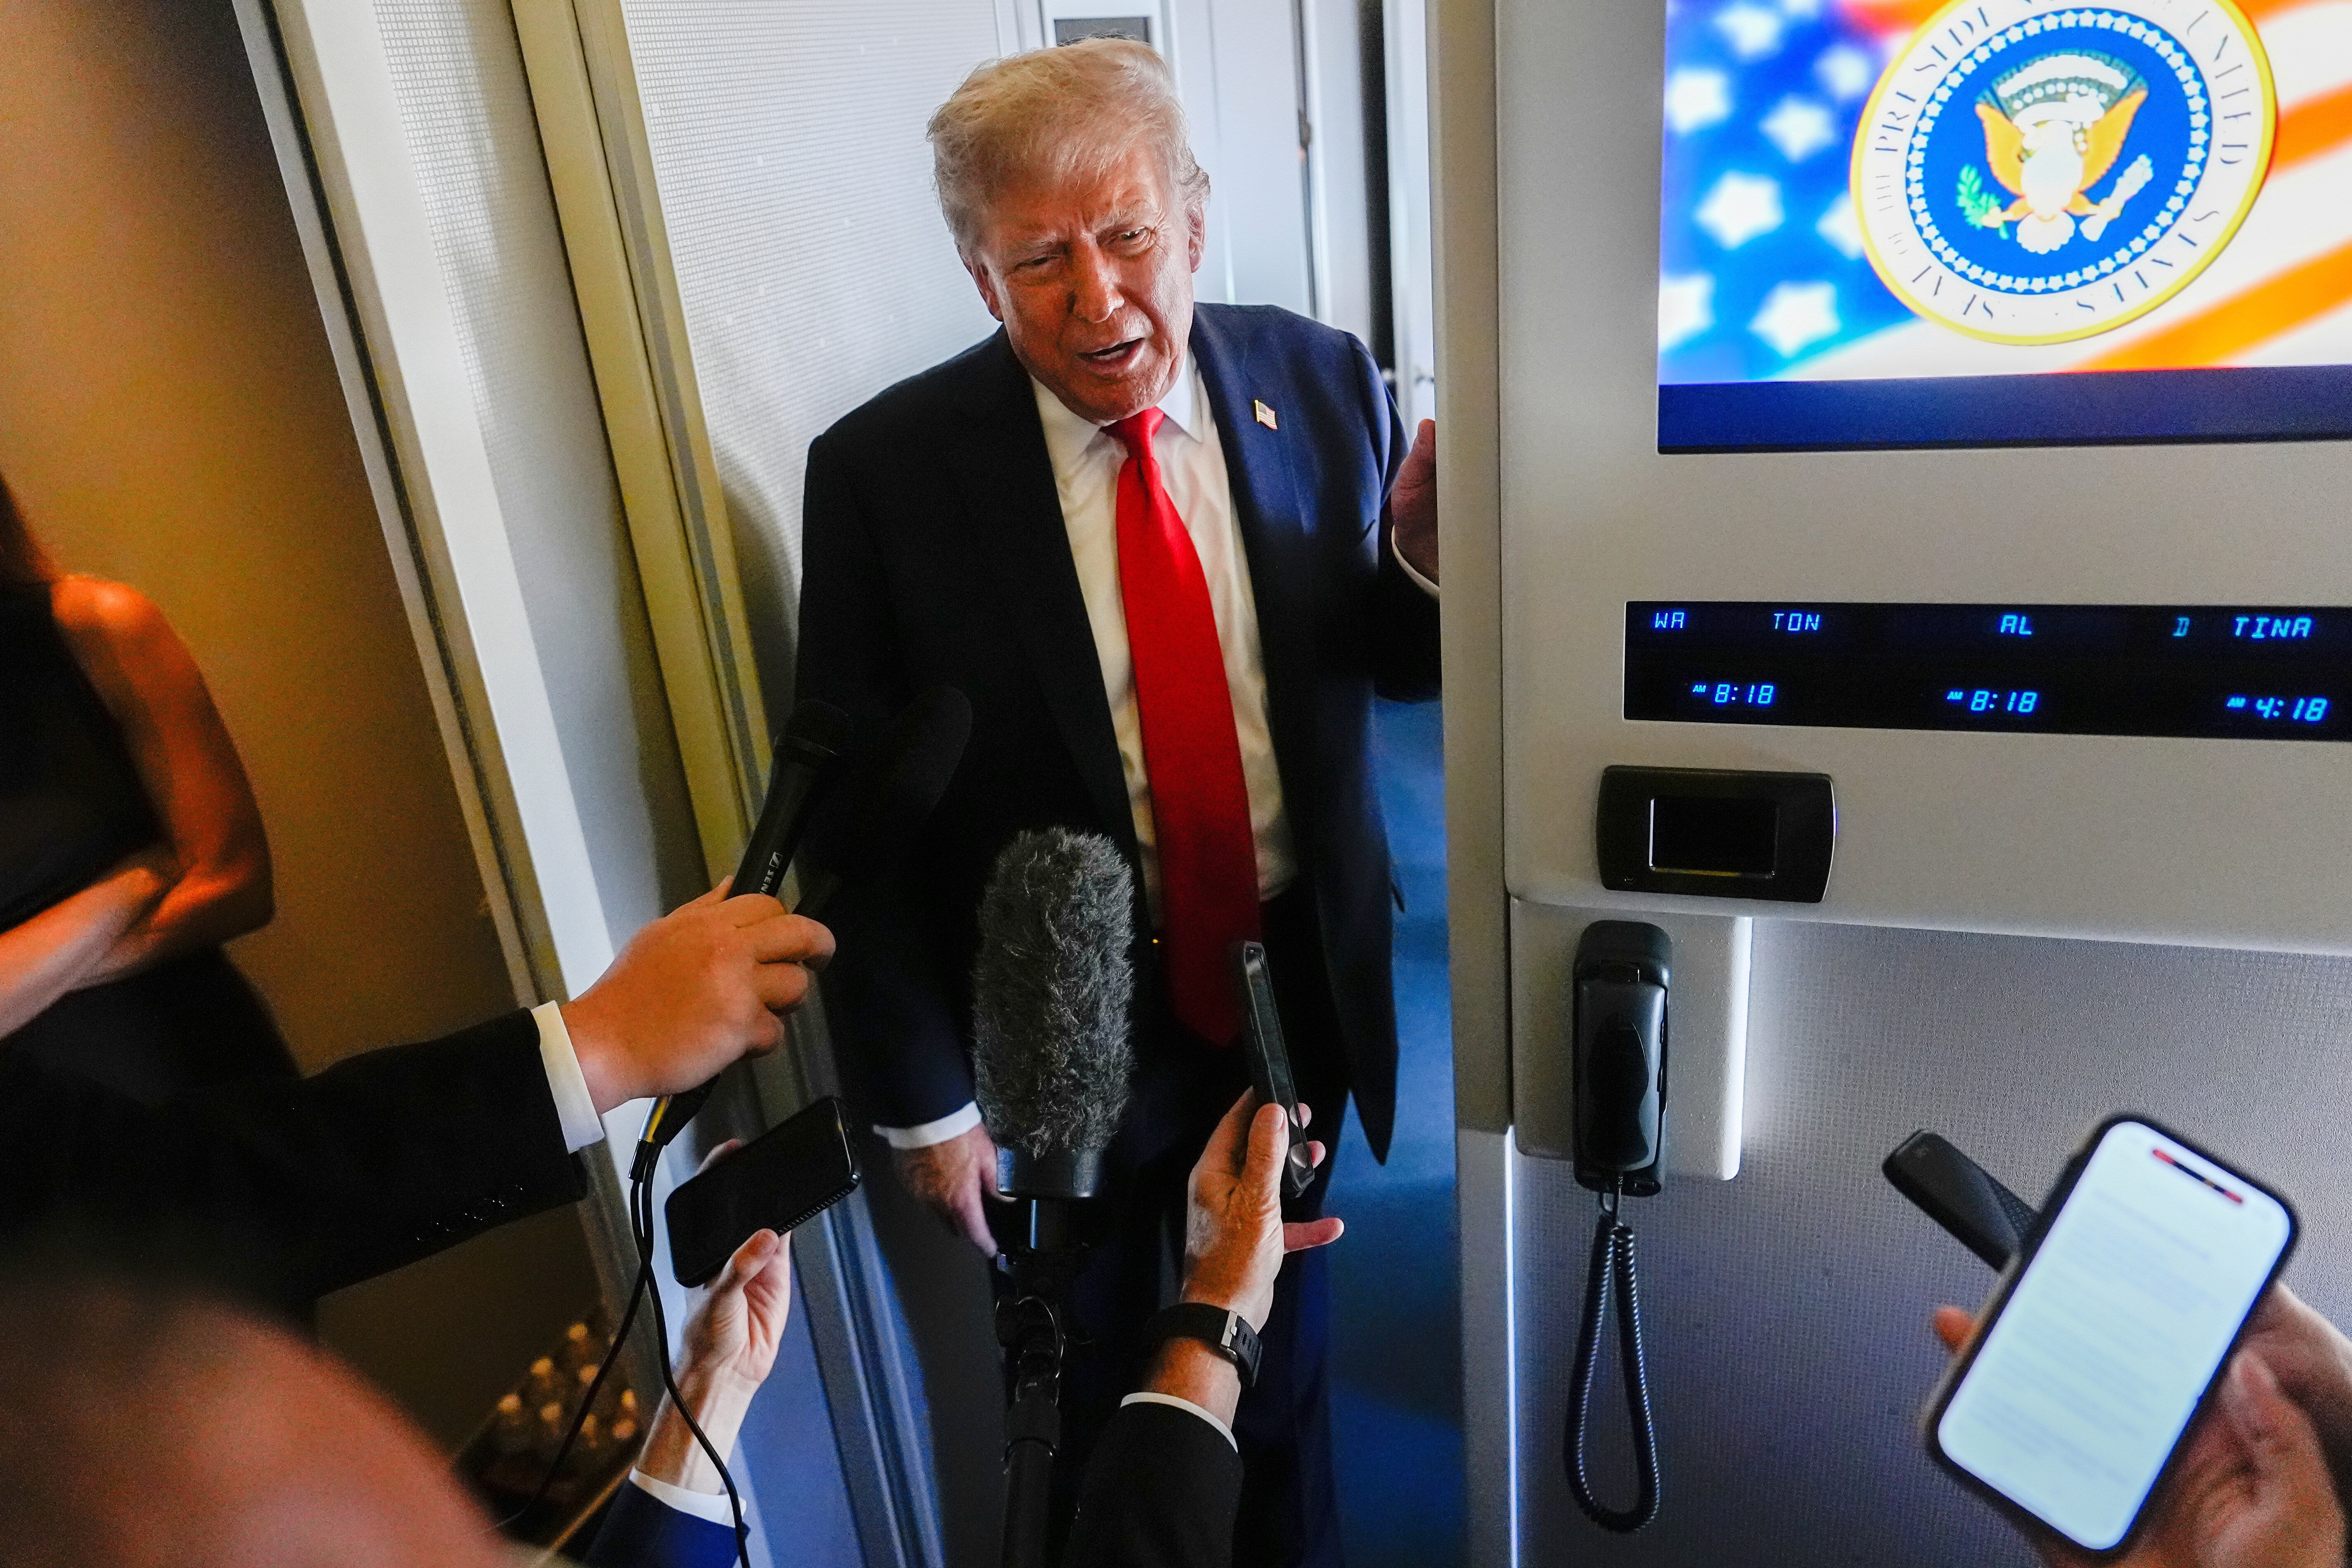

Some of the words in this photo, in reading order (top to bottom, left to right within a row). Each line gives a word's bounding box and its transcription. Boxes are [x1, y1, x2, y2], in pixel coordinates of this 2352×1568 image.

[1773, 613, 1820, 631] TON
[1999, 614, 2033, 635] AL
[2235, 616, 2312, 639] TINA
[1692, 684, 1707, 693] AM
[1714, 683, 1774, 705] 8:18
[1946, 691, 1964, 700] AM
[1970, 690, 2038, 713] 8:18
[2255, 696, 2328, 722] 4:18
[759, 869, 775, 895] SEN
